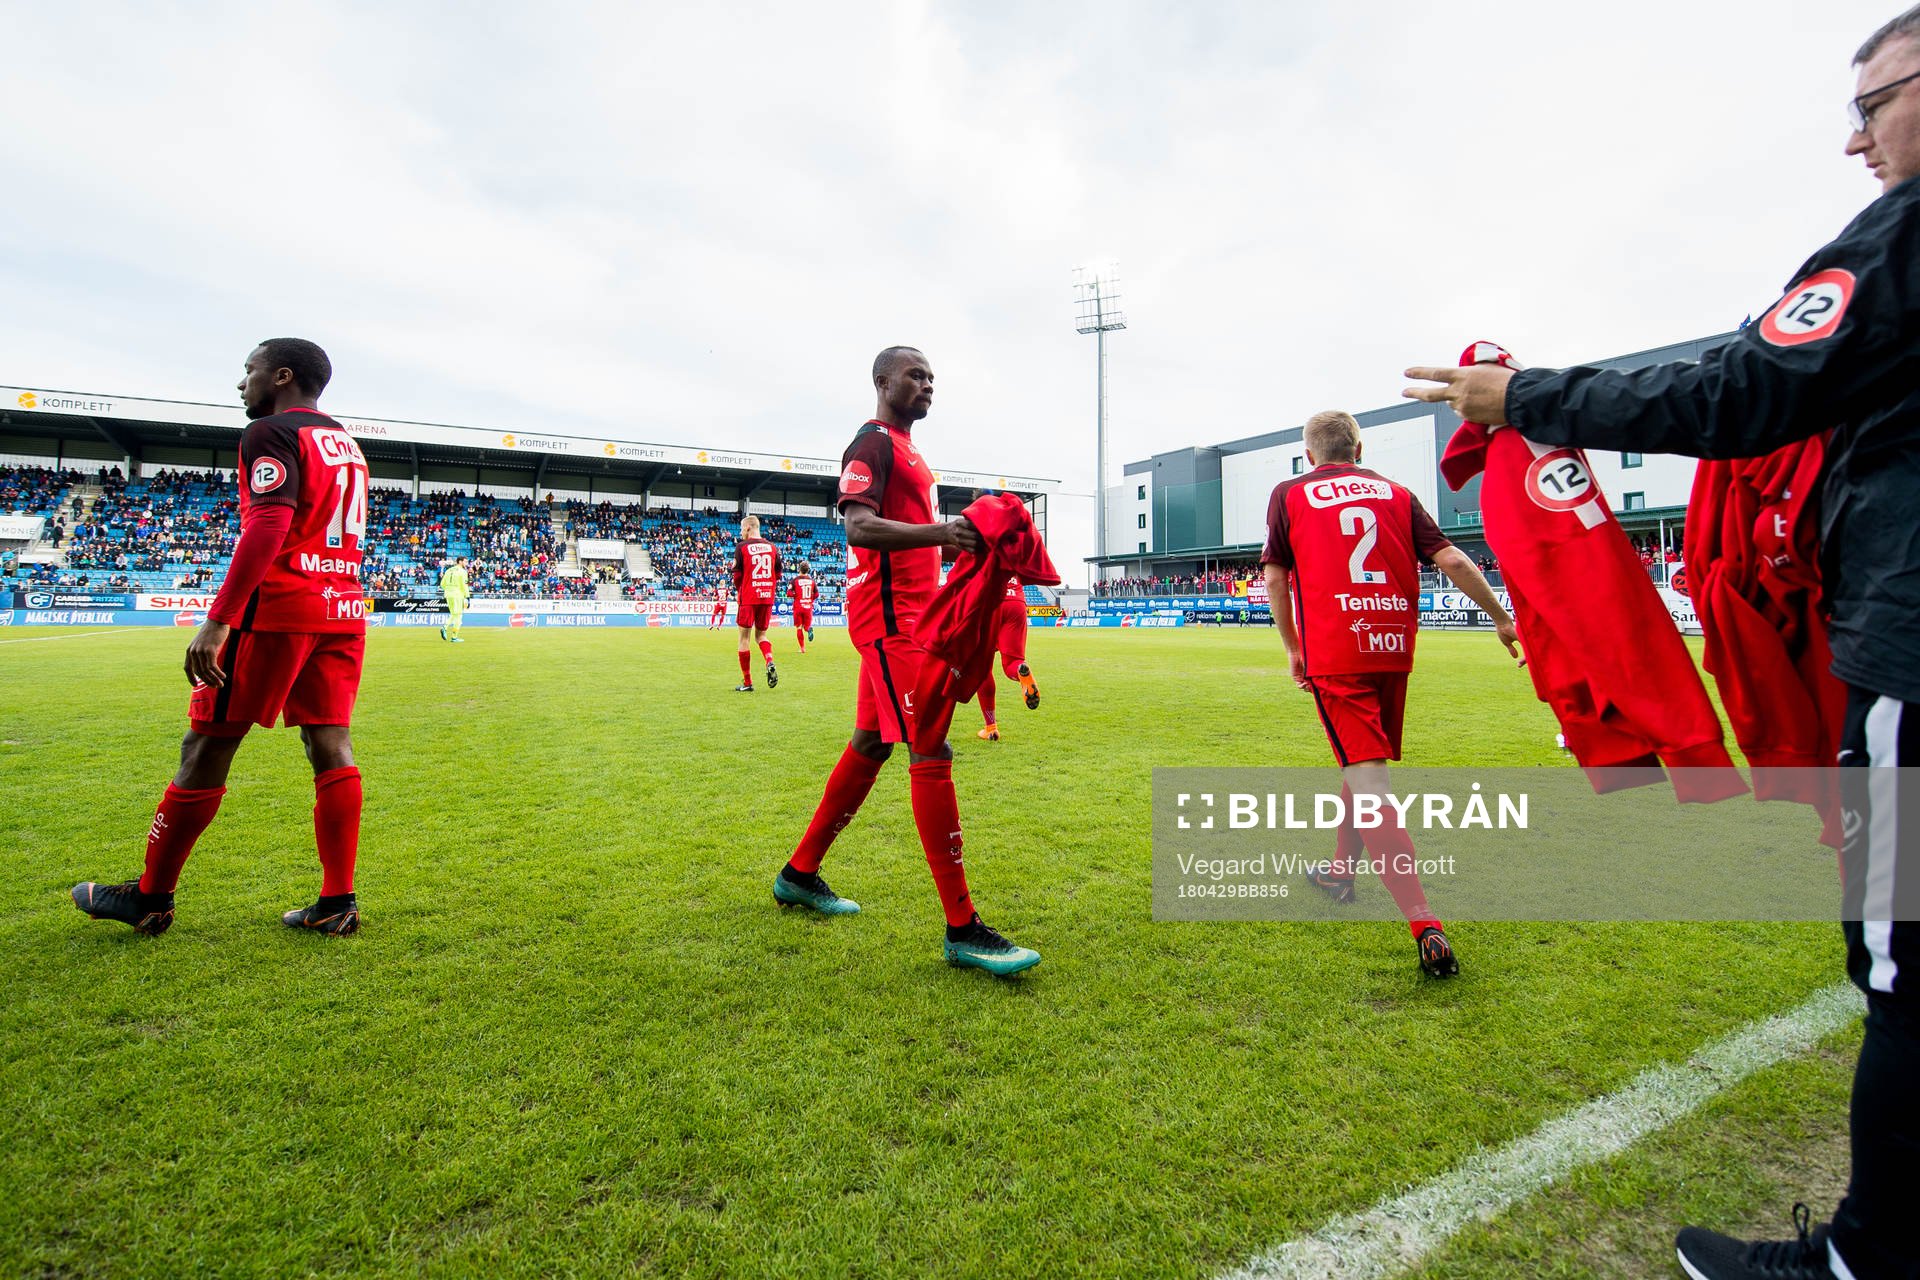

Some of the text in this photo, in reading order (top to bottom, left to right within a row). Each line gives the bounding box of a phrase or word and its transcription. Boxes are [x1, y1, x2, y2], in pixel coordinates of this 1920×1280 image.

[1785, 292, 1834, 327] 12
[42, 397, 113, 413] KOMPLETT
[347, 423, 387, 435] ARENA
[519, 438, 569, 450] KOMPLETT
[619, 447, 665, 458] KOMPLETT
[711, 455, 753, 465] KOMPLETT
[794, 462, 833, 472] KOMPLETT
[255, 467, 275, 482] 12
[942, 475, 976, 485] KOMPLETT
[1541, 462, 1588, 494] 12
[1008, 481, 1038, 490] KOMPLETT
[326, 466, 366, 551] 14
[1338, 506, 1387, 584] 2
[751, 554, 772, 579] 29
[801, 586, 812, 599] 10
[150, 597, 212, 608] SHAR
[1334, 592, 1408, 612] Teniste
[25, 611, 69, 624] MAGISKE
[1421, 609, 1468, 621] macron
[1671, 611, 1699, 622] San
[1368, 632, 1406, 652] MOT
